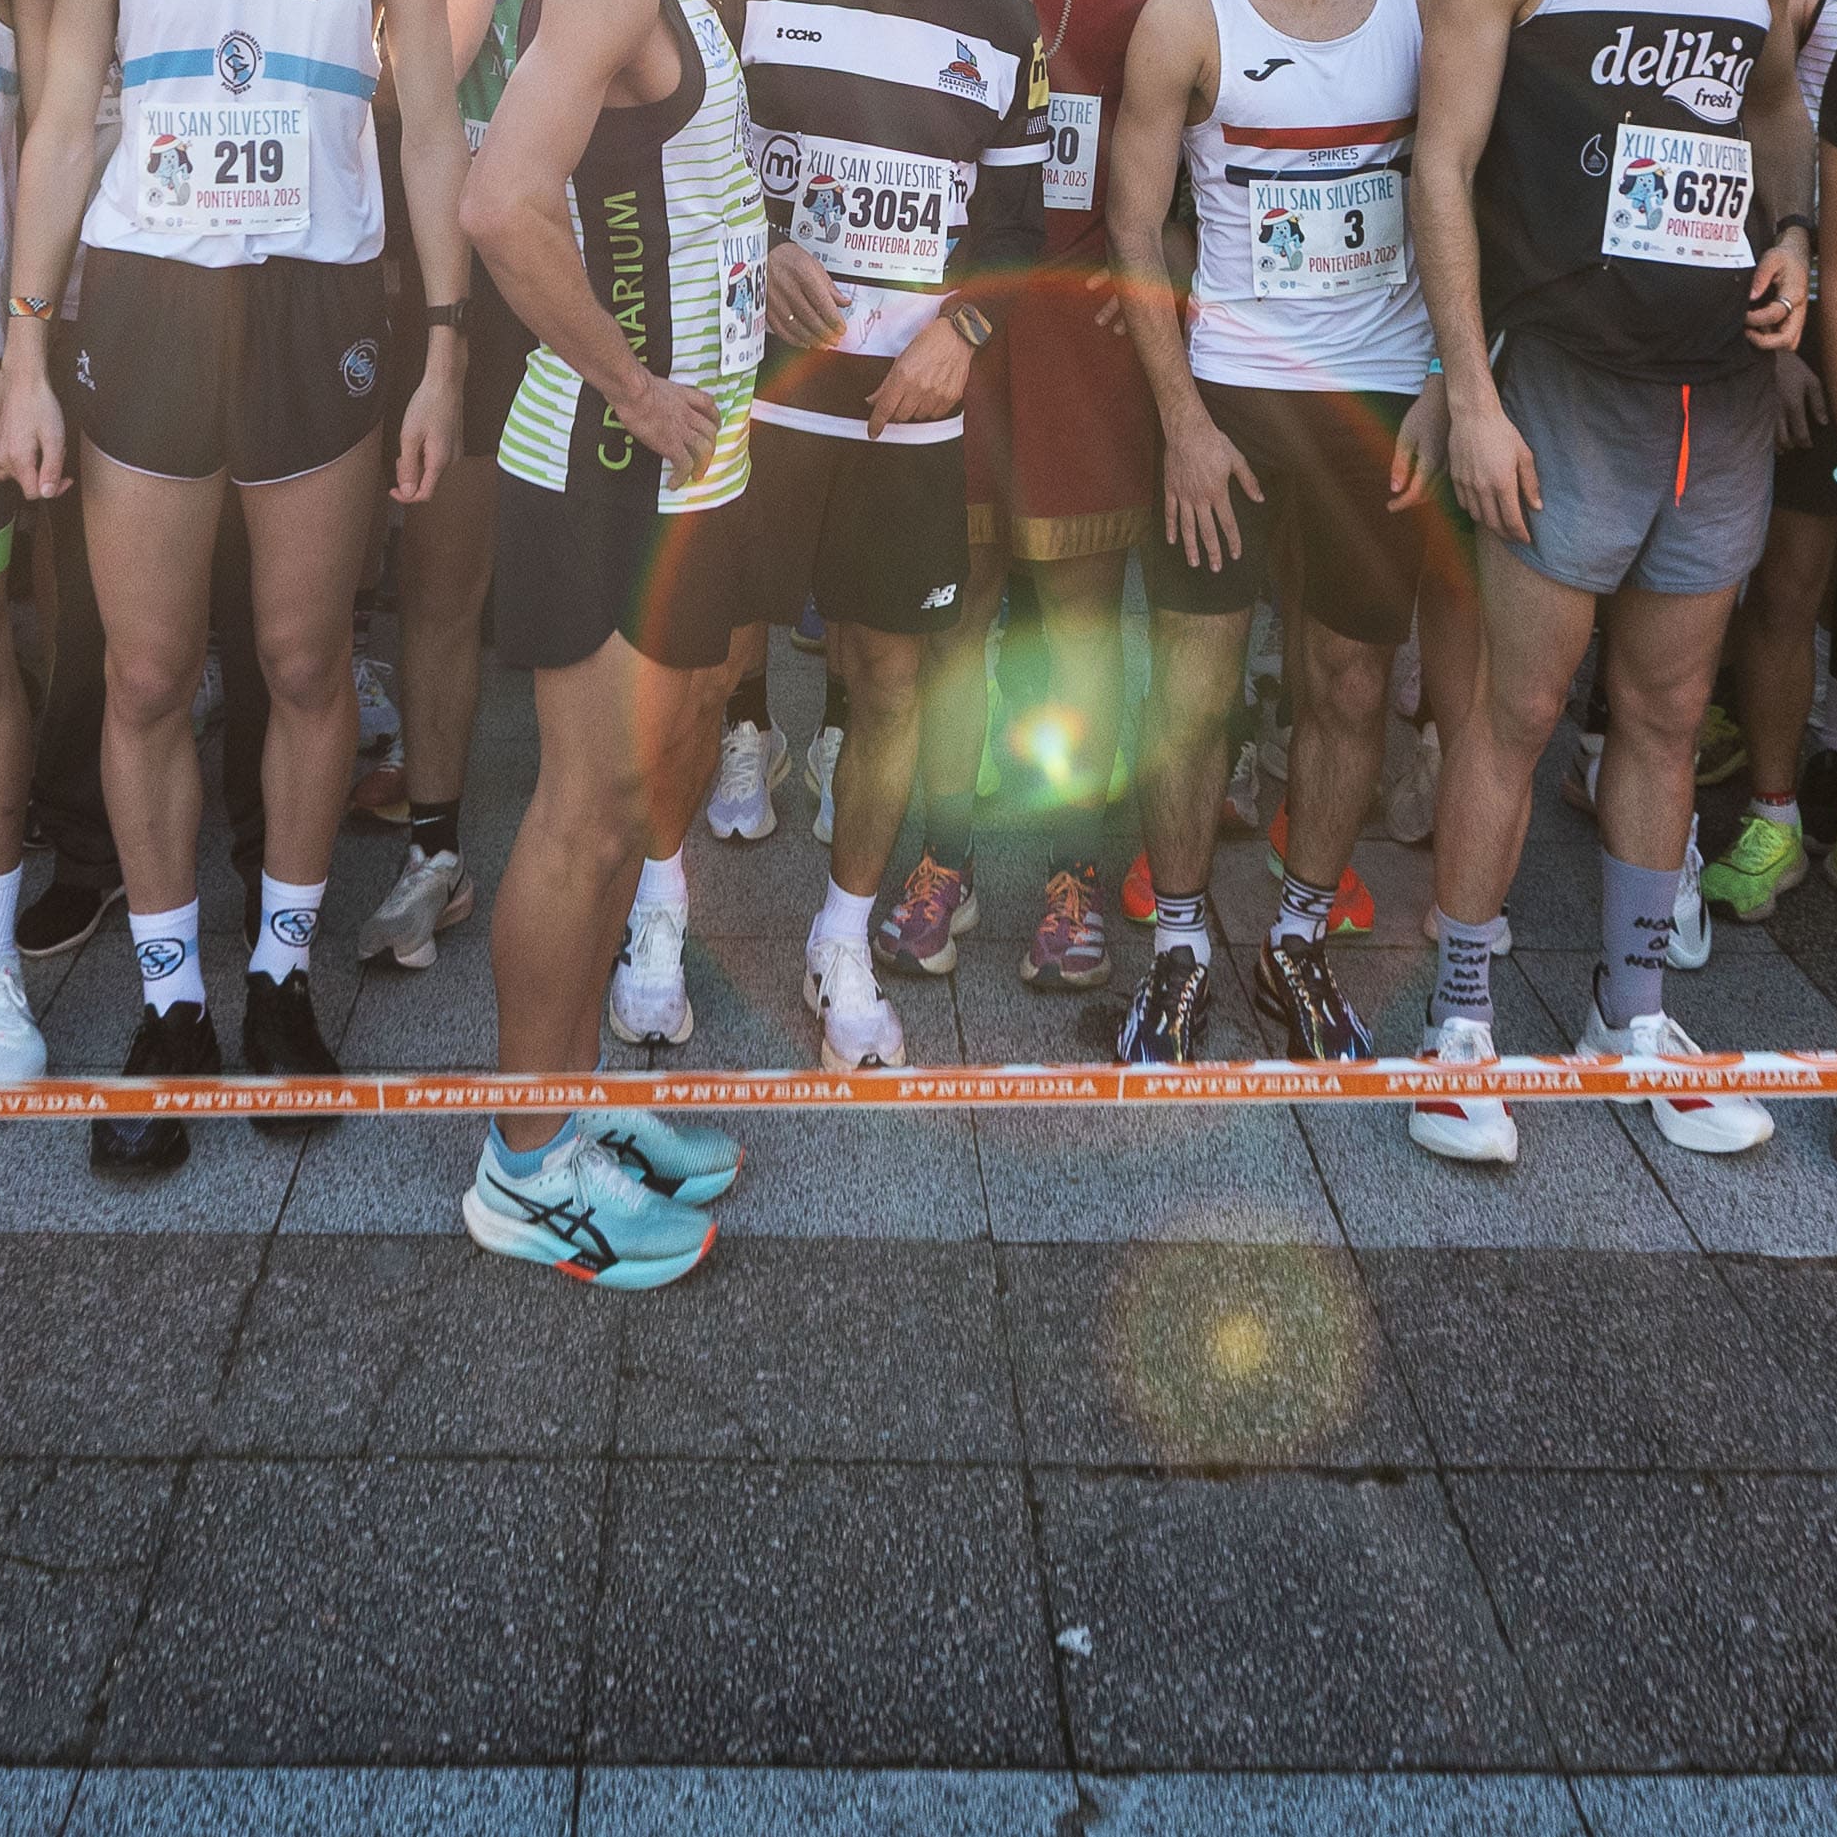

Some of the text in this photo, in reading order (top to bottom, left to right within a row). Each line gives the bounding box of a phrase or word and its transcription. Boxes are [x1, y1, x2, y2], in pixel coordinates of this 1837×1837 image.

[786, 29, 822, 42] OCHO
[1049, 99, 1092, 125] ESTRE
[1694, 87, 1733, 109] fresh
[148, 109, 301, 137] XLII SAN SILVESTRE
[214, 139, 283, 184] 219
[1308, 147, 1360, 163] SPIKES
[1623, 131, 1748, 174] XLII SAN SILVESTRE
[807, 149, 835, 177] XLII
[838, 156, 870, 183] SAN
[874, 160, 942, 190] SILVESTRE
[1063, 170, 1087, 187] 2025
[196, 188, 301, 208] PONTEVEDRA 2025
[1256, 175, 1394, 210] XLII SAN SILVESTRE
[1674, 169, 1748, 219] 6375
[848, 187, 941, 235] 3054
[1344, 209, 1365, 249] 3
[722, 236, 744, 266] XLII
[844, 232, 938, 257] PONTEVEDRA 2025
[1309, 244, 1397, 273] PONTEVEDRA 2025
